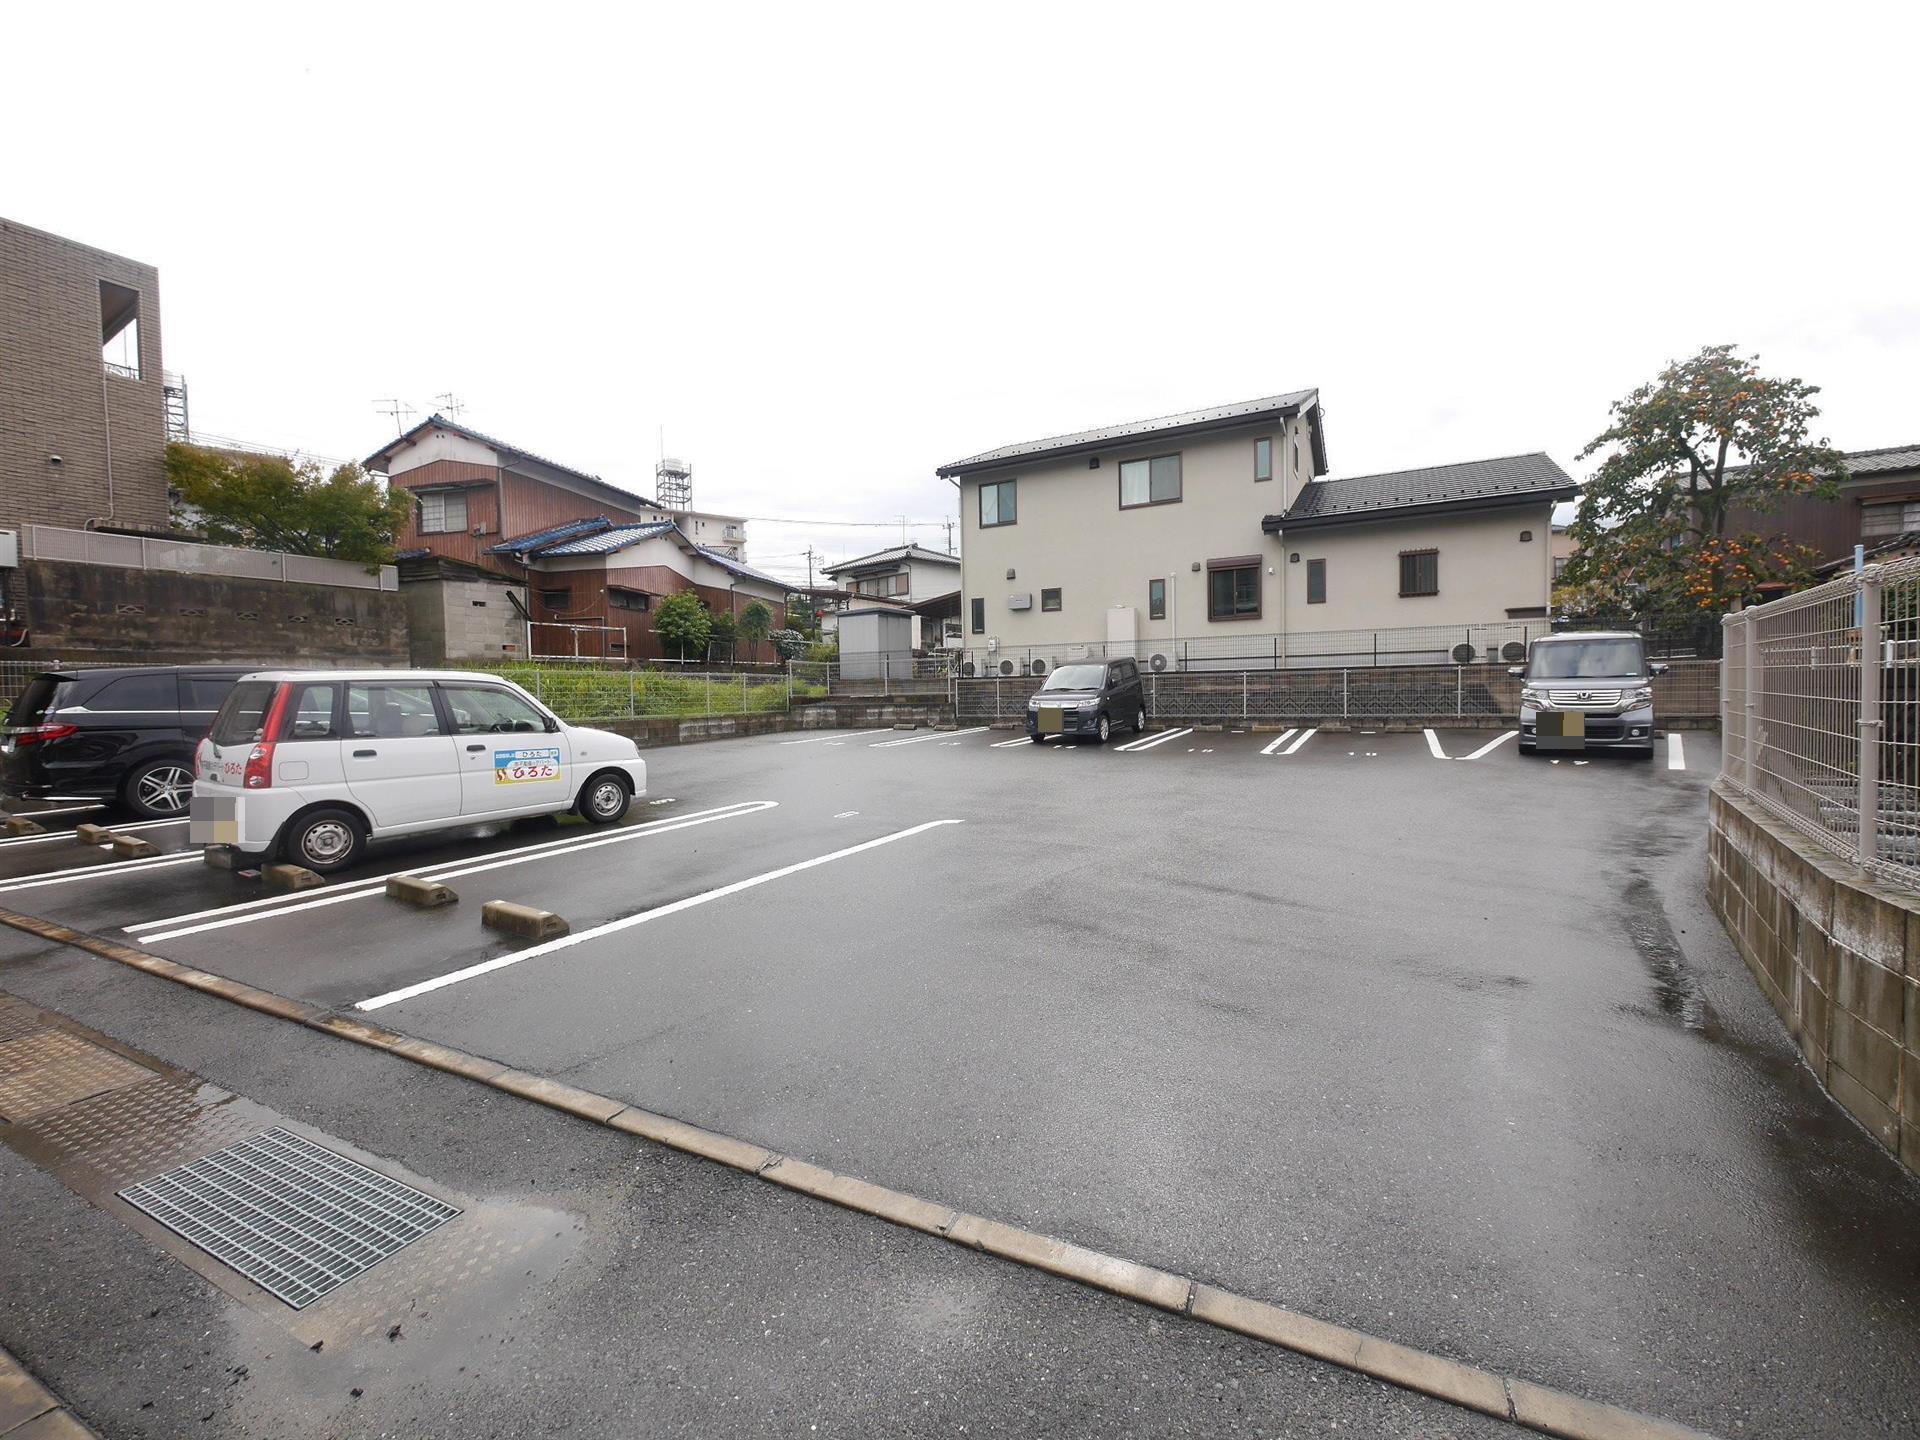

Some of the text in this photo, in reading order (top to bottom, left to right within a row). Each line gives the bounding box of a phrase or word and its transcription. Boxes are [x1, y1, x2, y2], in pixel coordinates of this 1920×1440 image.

[224, 761, 242, 775] ひろた
[512, 765, 553, 779] ひろた
